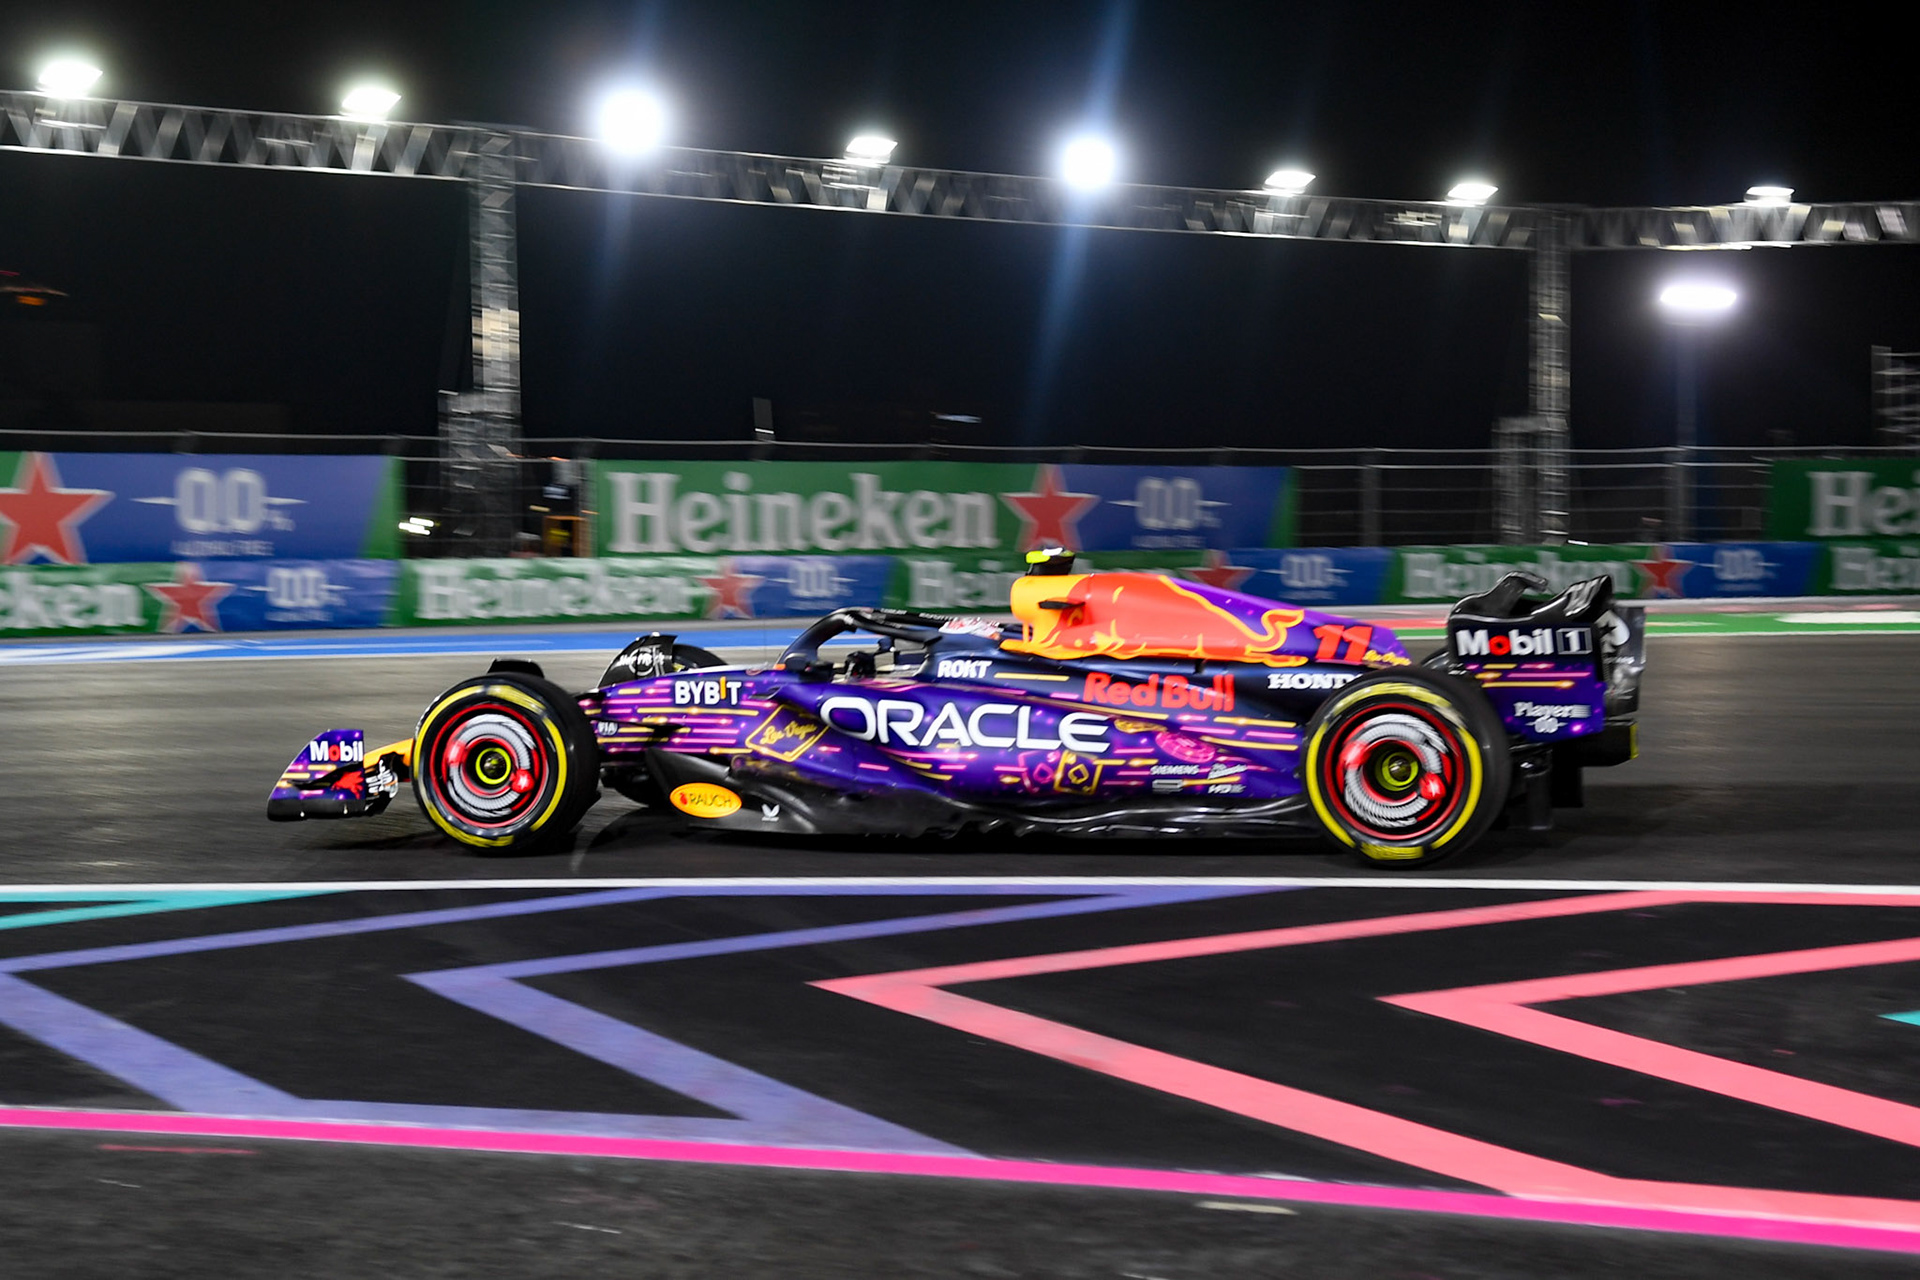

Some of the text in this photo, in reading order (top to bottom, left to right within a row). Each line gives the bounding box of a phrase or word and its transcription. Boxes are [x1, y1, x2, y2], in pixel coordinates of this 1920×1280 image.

[606, 471, 1000, 554] Heineken
[414, 564, 695, 619] Heineken
[1313, 624, 1373, 662] 11
[1456, 627, 1554, 656] Mobil
[937, 659, 992, 679] ROKT
[1267, 673, 1364, 690] HOND
[675, 676, 742, 705] BYBIT
[1083, 671, 1236, 712] Red Bull
[820, 696, 1111, 753] ORACLE
[310, 740, 364, 762] Mobil
[1150, 764, 1200, 776] SIEMENS
[689, 793, 733, 808] RAUCH
